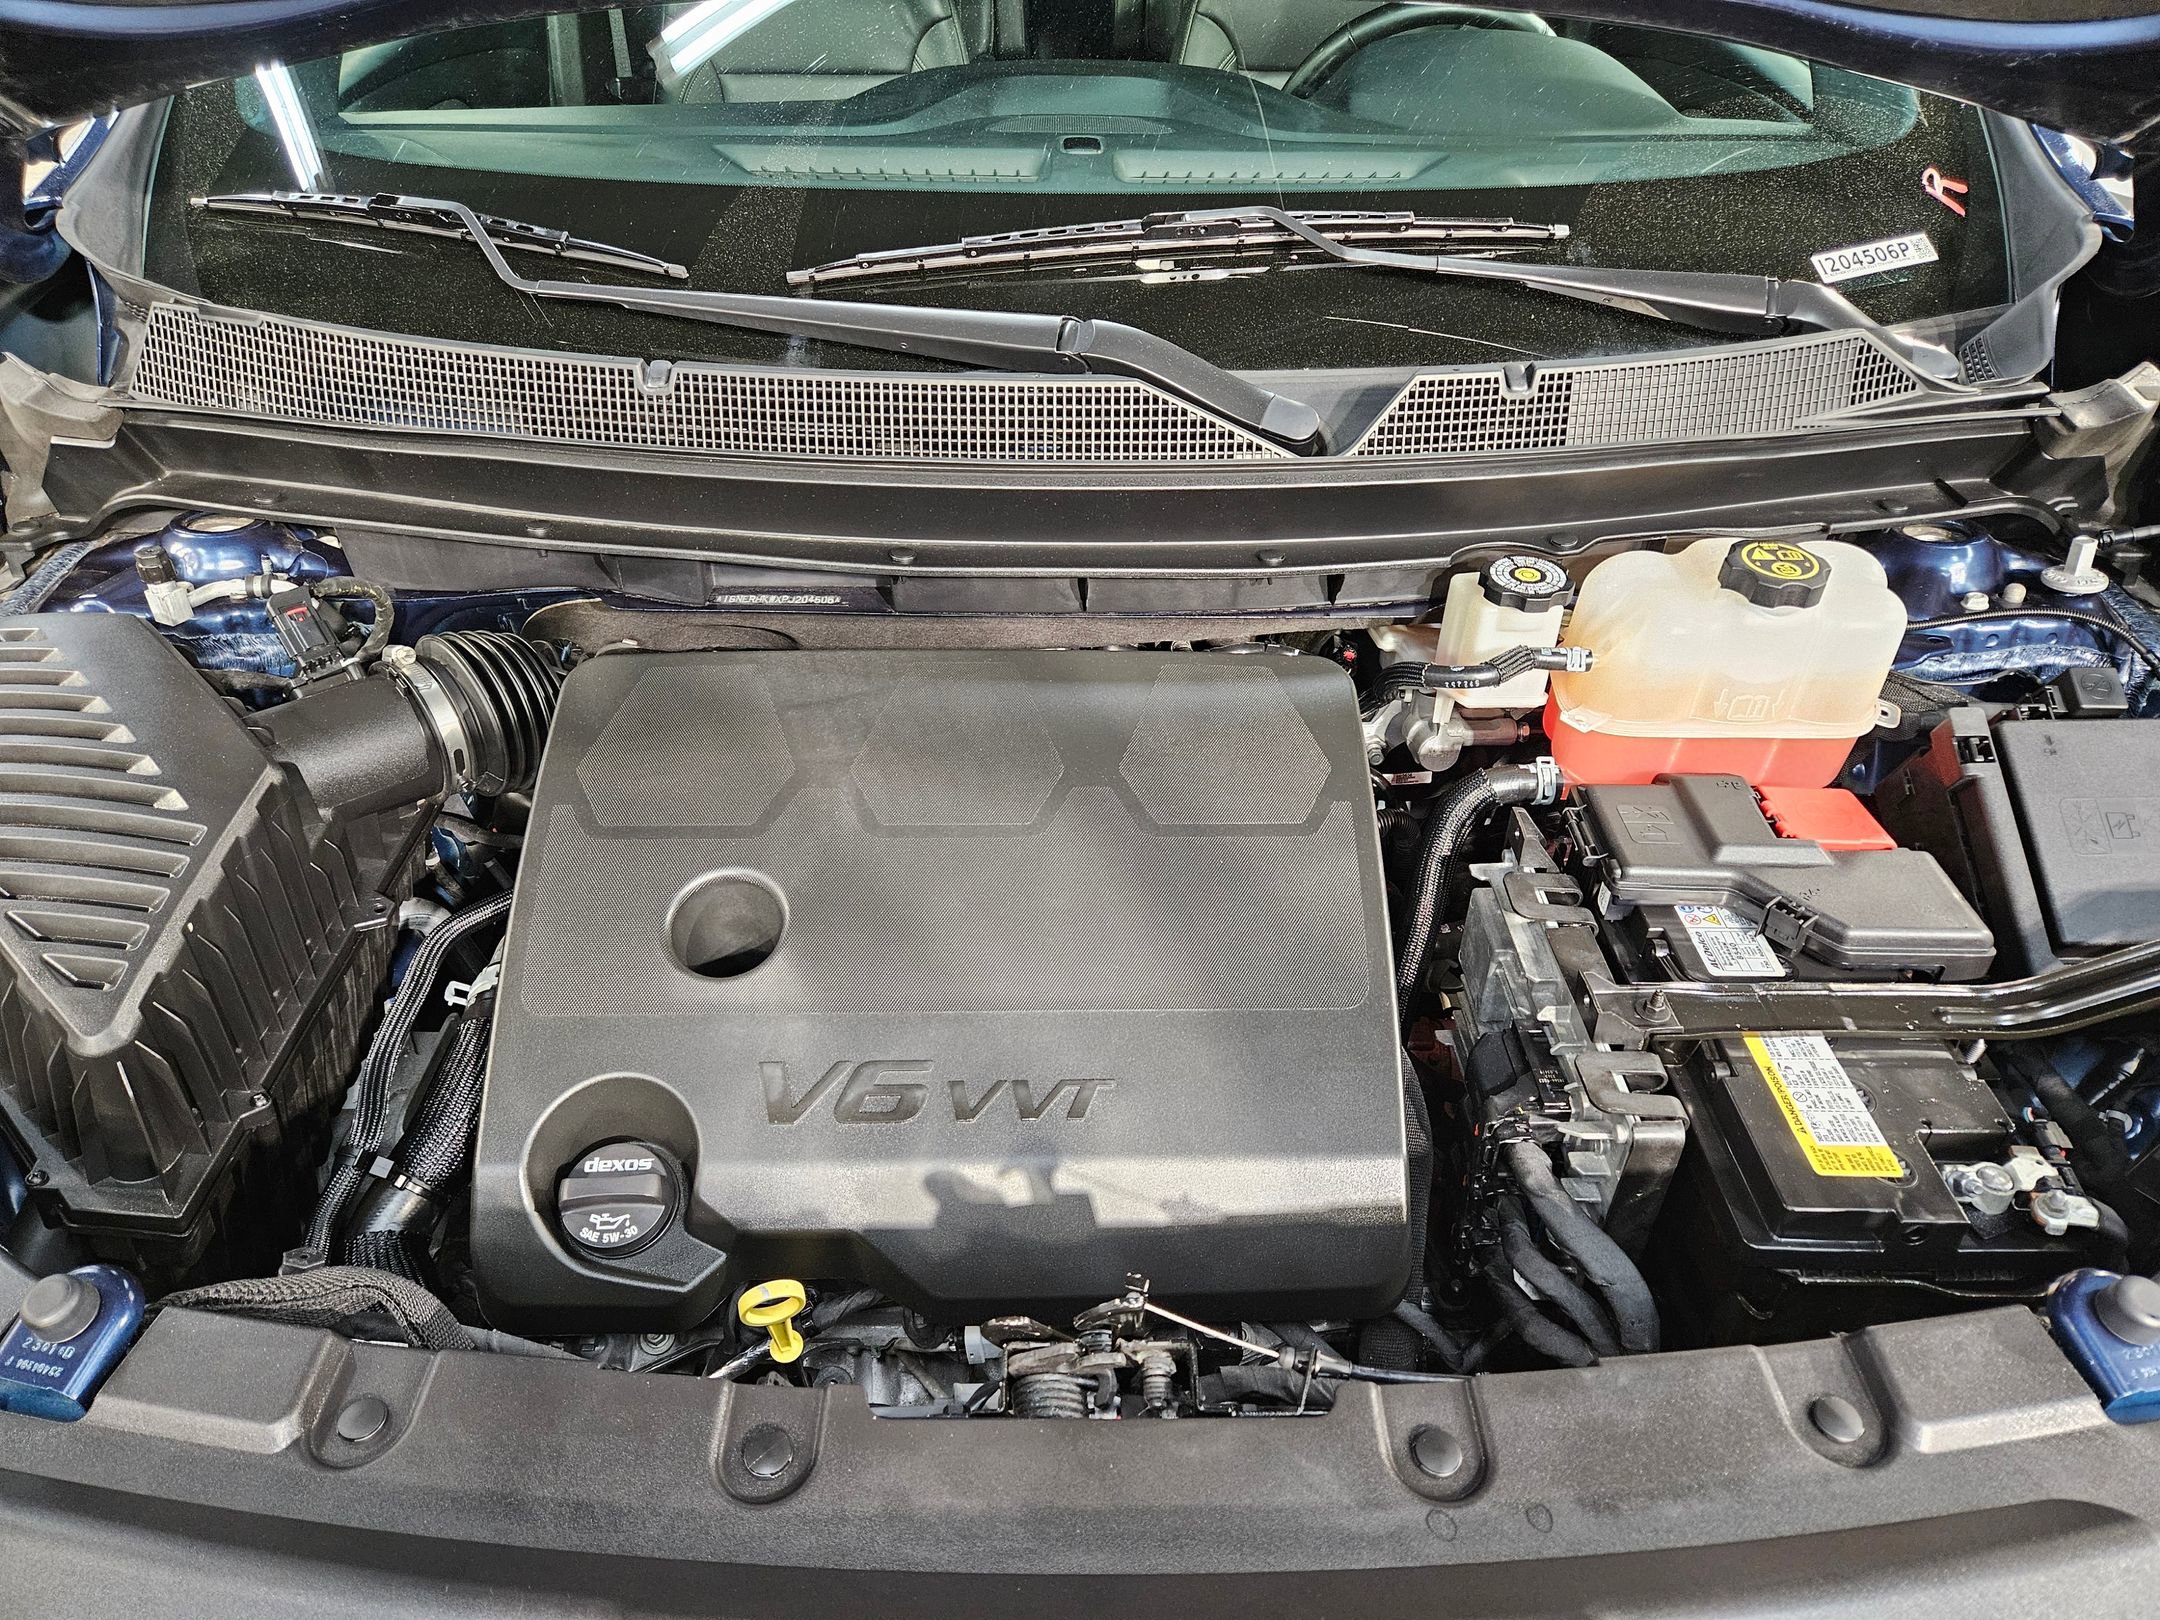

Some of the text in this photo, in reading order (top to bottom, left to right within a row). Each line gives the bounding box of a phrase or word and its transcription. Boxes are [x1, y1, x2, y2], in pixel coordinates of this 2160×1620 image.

[1922, 165, 1969, 217] R
[759, 1060, 1116, 1126] V6 VVT
[583, 1157, 655, 1173] dexos
[579, 1225, 639, 1243] SAE 5W-30
